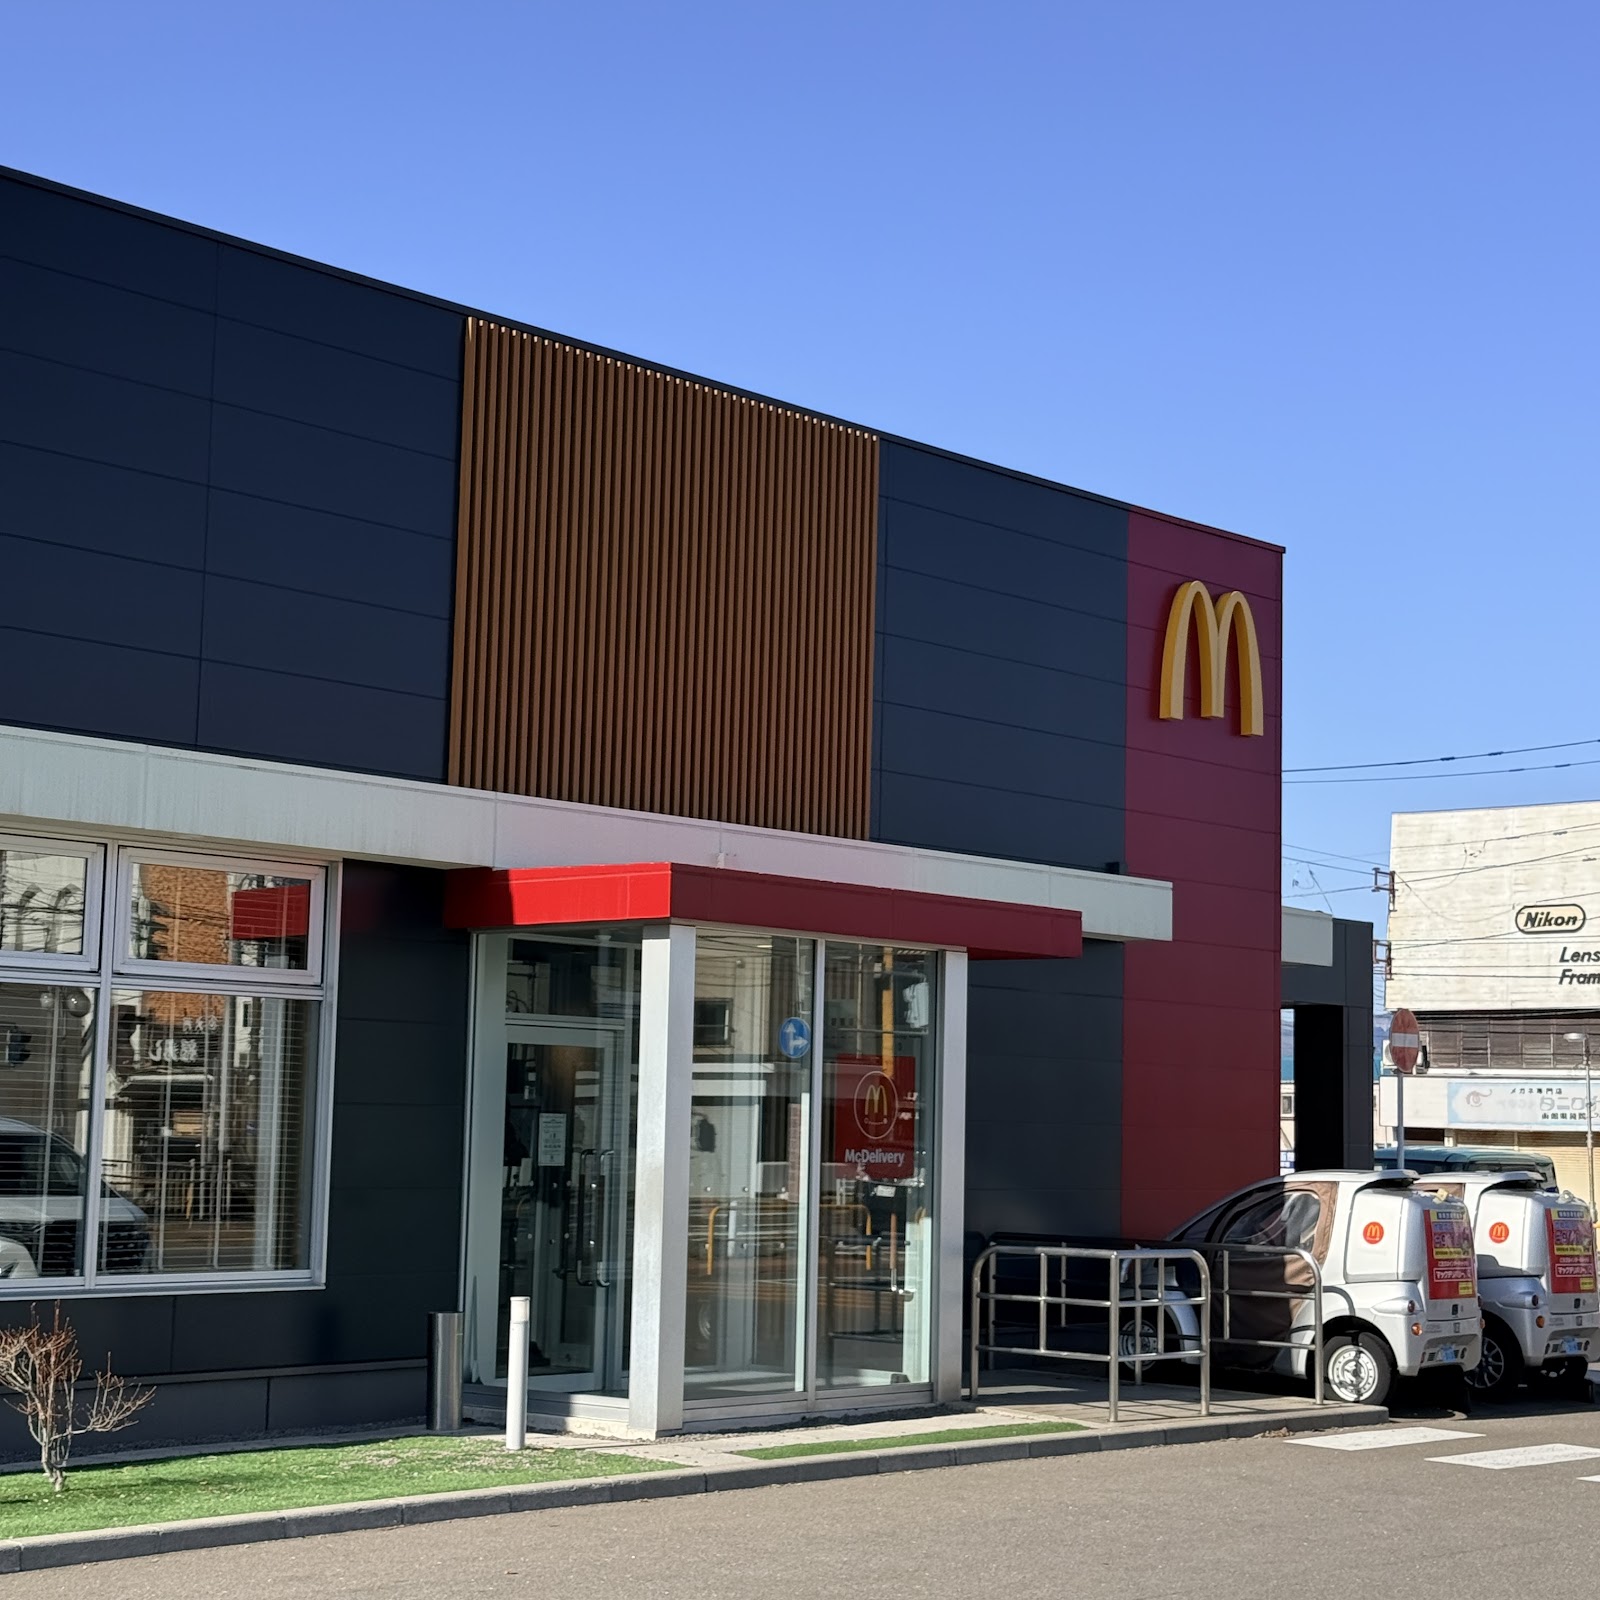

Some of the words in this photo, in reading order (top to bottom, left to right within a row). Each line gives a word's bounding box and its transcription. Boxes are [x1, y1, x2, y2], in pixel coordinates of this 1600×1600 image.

[1523, 911, 1578, 928] Nikon
[1559, 946, 1600, 963] Lens
[844, 1148, 905, 1167] McDelivery
